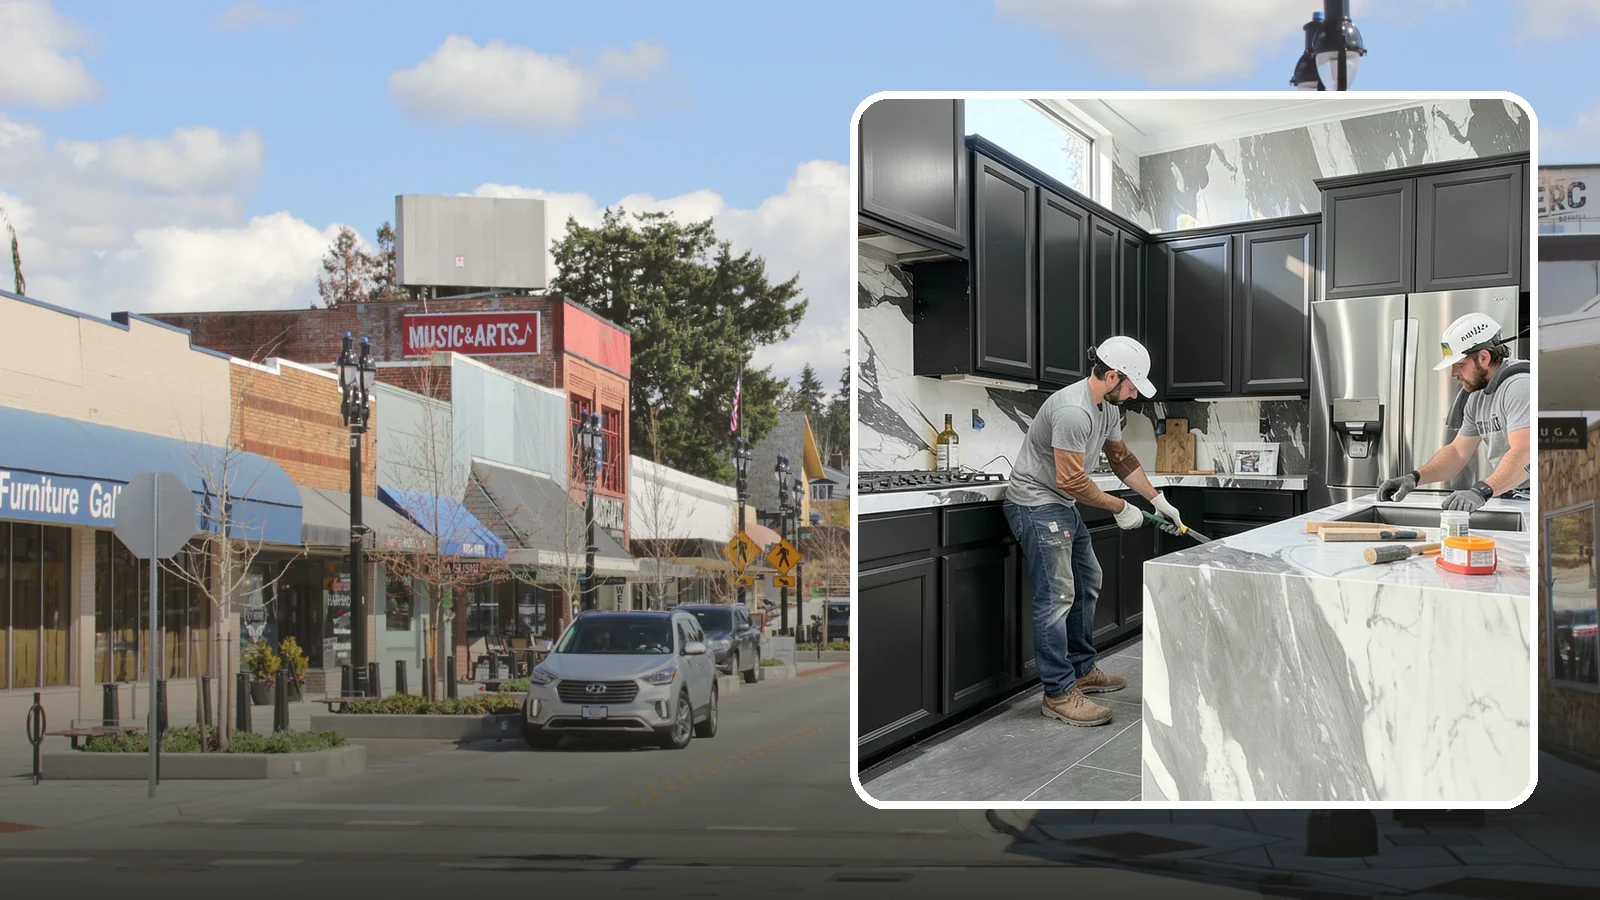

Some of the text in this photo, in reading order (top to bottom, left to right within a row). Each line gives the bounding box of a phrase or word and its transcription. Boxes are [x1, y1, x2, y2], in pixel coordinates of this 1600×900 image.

[409, 323, 519, 348] MUSIC&ARTS
[0, 472, 122, 518] Furniture Gal
